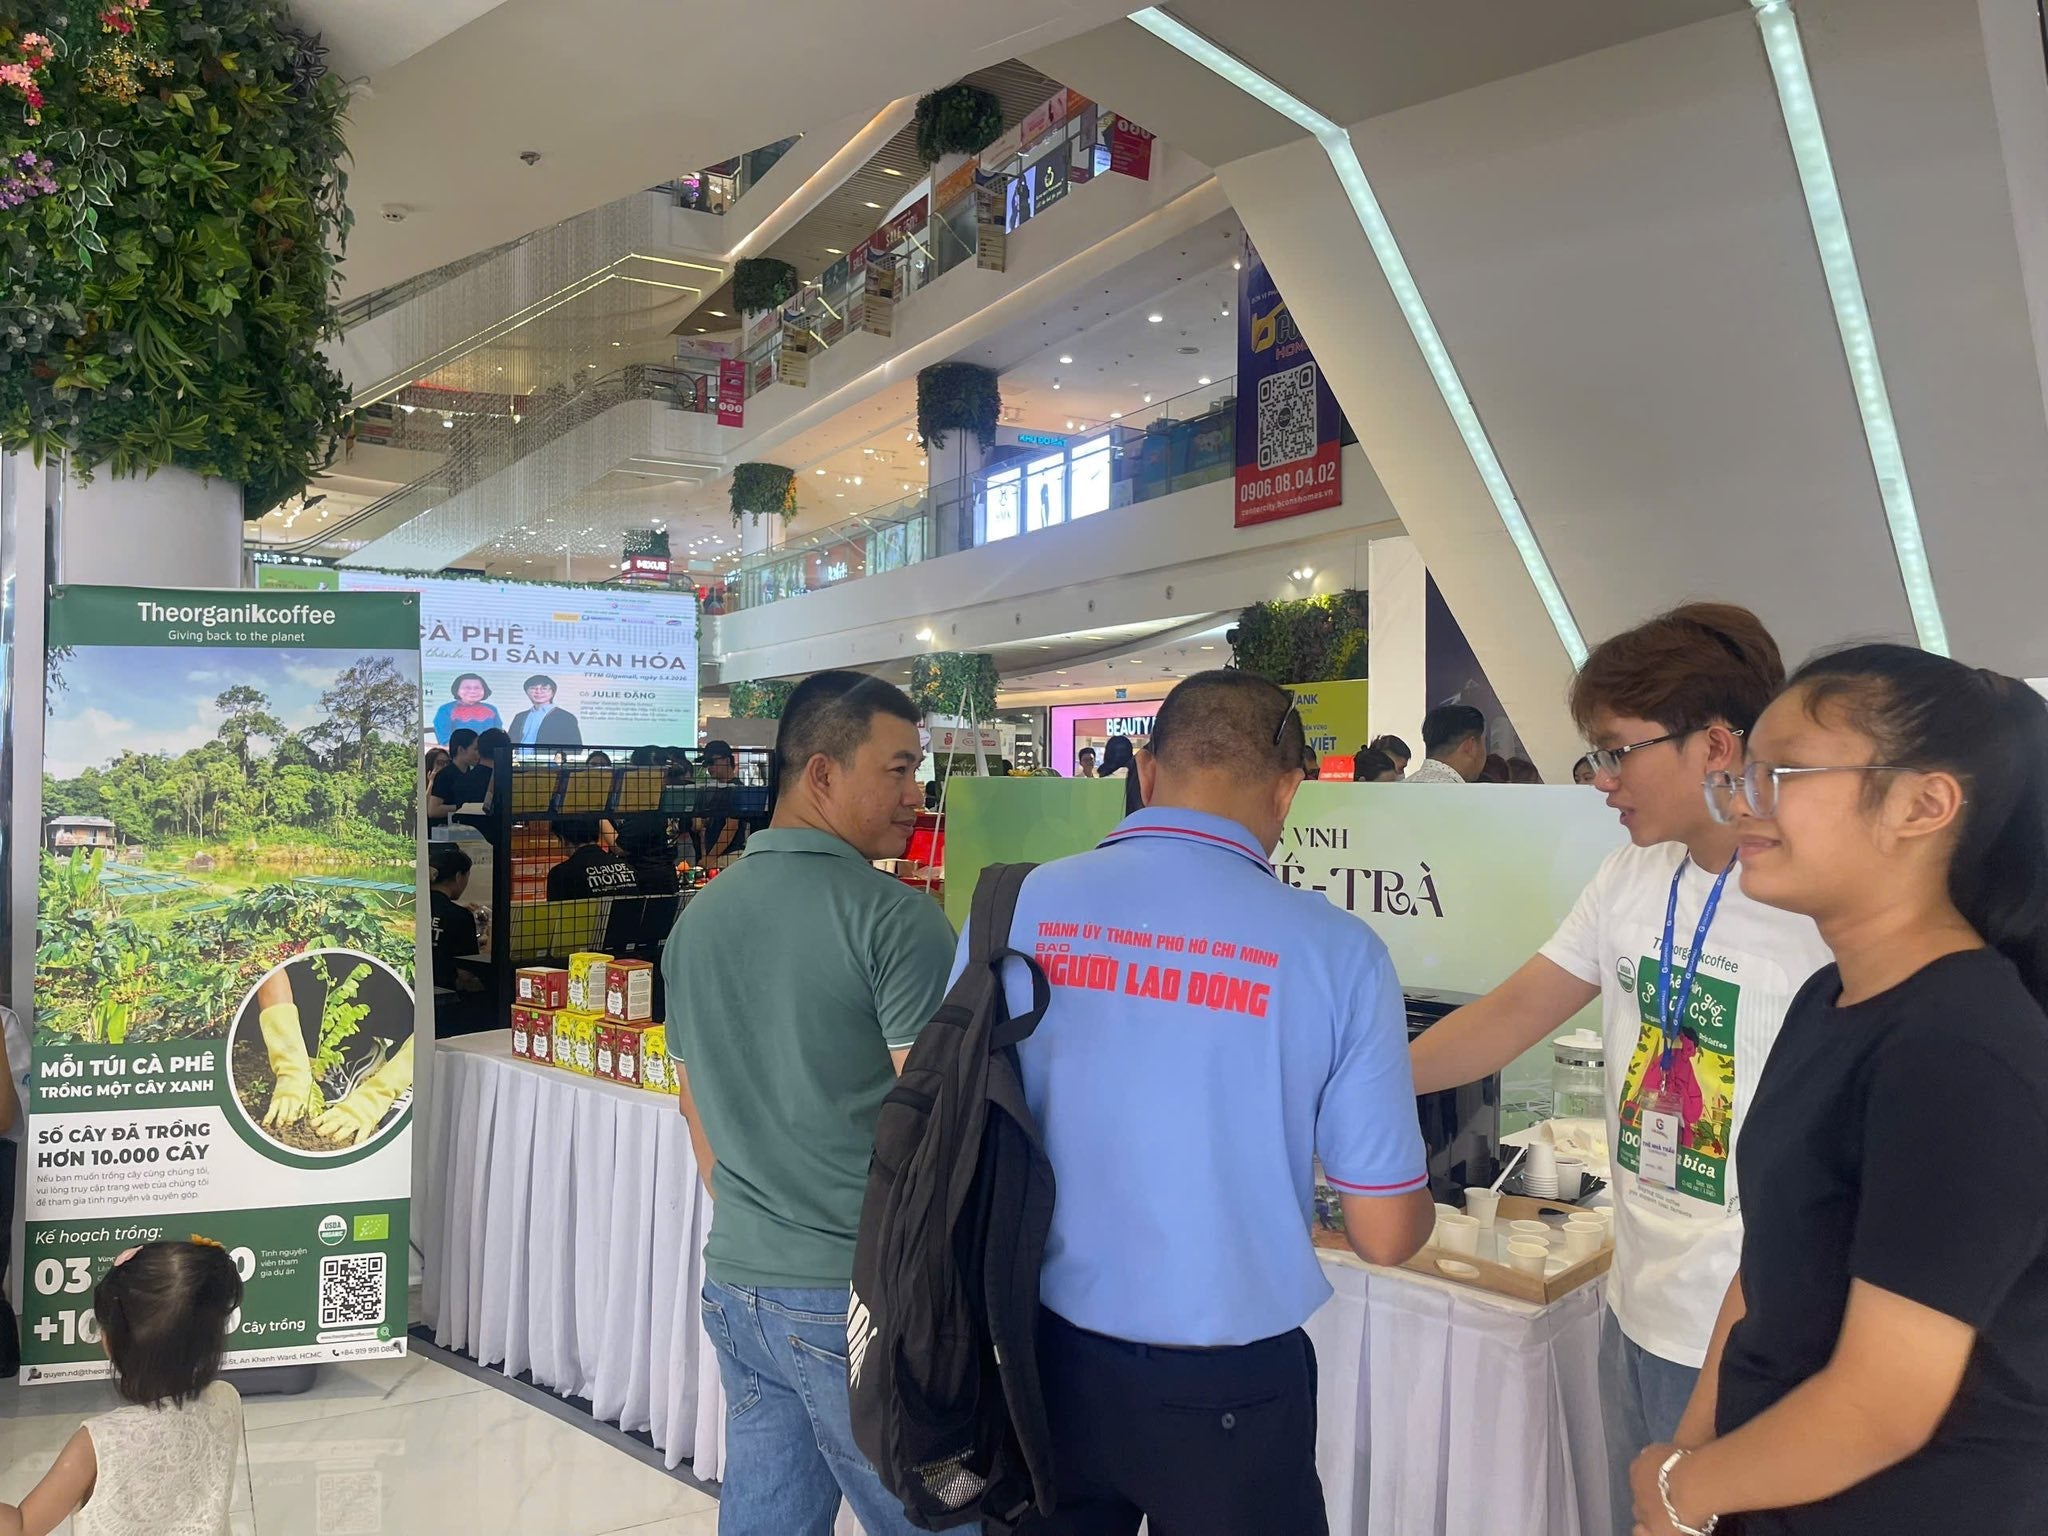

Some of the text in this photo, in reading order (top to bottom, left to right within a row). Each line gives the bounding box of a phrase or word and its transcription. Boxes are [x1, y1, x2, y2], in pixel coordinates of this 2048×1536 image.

[1241, 461, 1335, 502] 0906.08.04.02
[137, 602, 336, 627] Theorganikcoffee
[168, 630, 305, 643] Giving back to the planet
[462, 624, 524, 645] PHÊ
[471, 647, 497, 662] DI
[506, 644, 559, 665] SẢN
[568, 648, 622, 667] VĂN
[632, 651, 686, 670] HÓA
[592, 690, 620, 698] JULIE
[624, 690, 656, 700] ĐẶNG
[1106, 716, 1151, 736] BEAUTY
[1310, 733, 1337, 755] VIỆT
[1293, 827, 1349, 849] VINH
[586, 863, 629, 875] CLAUDE
[1239, 945, 1279, 969] MINH
[1124, 961, 1182, 1002] LAO
[1186, 970, 1272, 1018] ĐỘNG
[41, 1051, 215, 1078] MỖI TÚI CÀ PHÊ
[40, 1079, 214, 1098] TRỒNG MỘT CÂY XANH
[38, 1119, 210, 1144] SỐ CÂY ĐÃ TRỒNG
[1621, 1129, 1640, 1147] 100
[38, 1141, 209, 1168] HƠN 10.000 CÂY
[56, 1173, 71, 1183] bạn
[127, 1170, 142, 1180] cây
[167, 1168, 194, 1178] chúng
[71, 1185, 88, 1195] truy
[107, 1182, 129, 1193] trang
[132, 1181, 150, 1190] web
[169, 1178, 196, 1189] chúng
[49, 1198, 71, 1206] tham
[72, 1196, 86, 1206] gia
[35, 1224, 163, 1245] Kế hoạch trồng:
[278, 1258, 299, 1266] tham
[34, 1257, 92, 1295] 03
[260, 1269, 273, 1278] gia
[241, 1318, 306, 1335] Cây trồng
[251, 1355, 276, 1364] Khanh
[300, 1351, 322, 1359] HCMC
[341, 1348, 354, 1356] +84
[355, 1347, 367, 1355] 919
[368, 1346, 380, 1354] 991
[43, 1367, 112, 1379] quyen.nd@theorg
